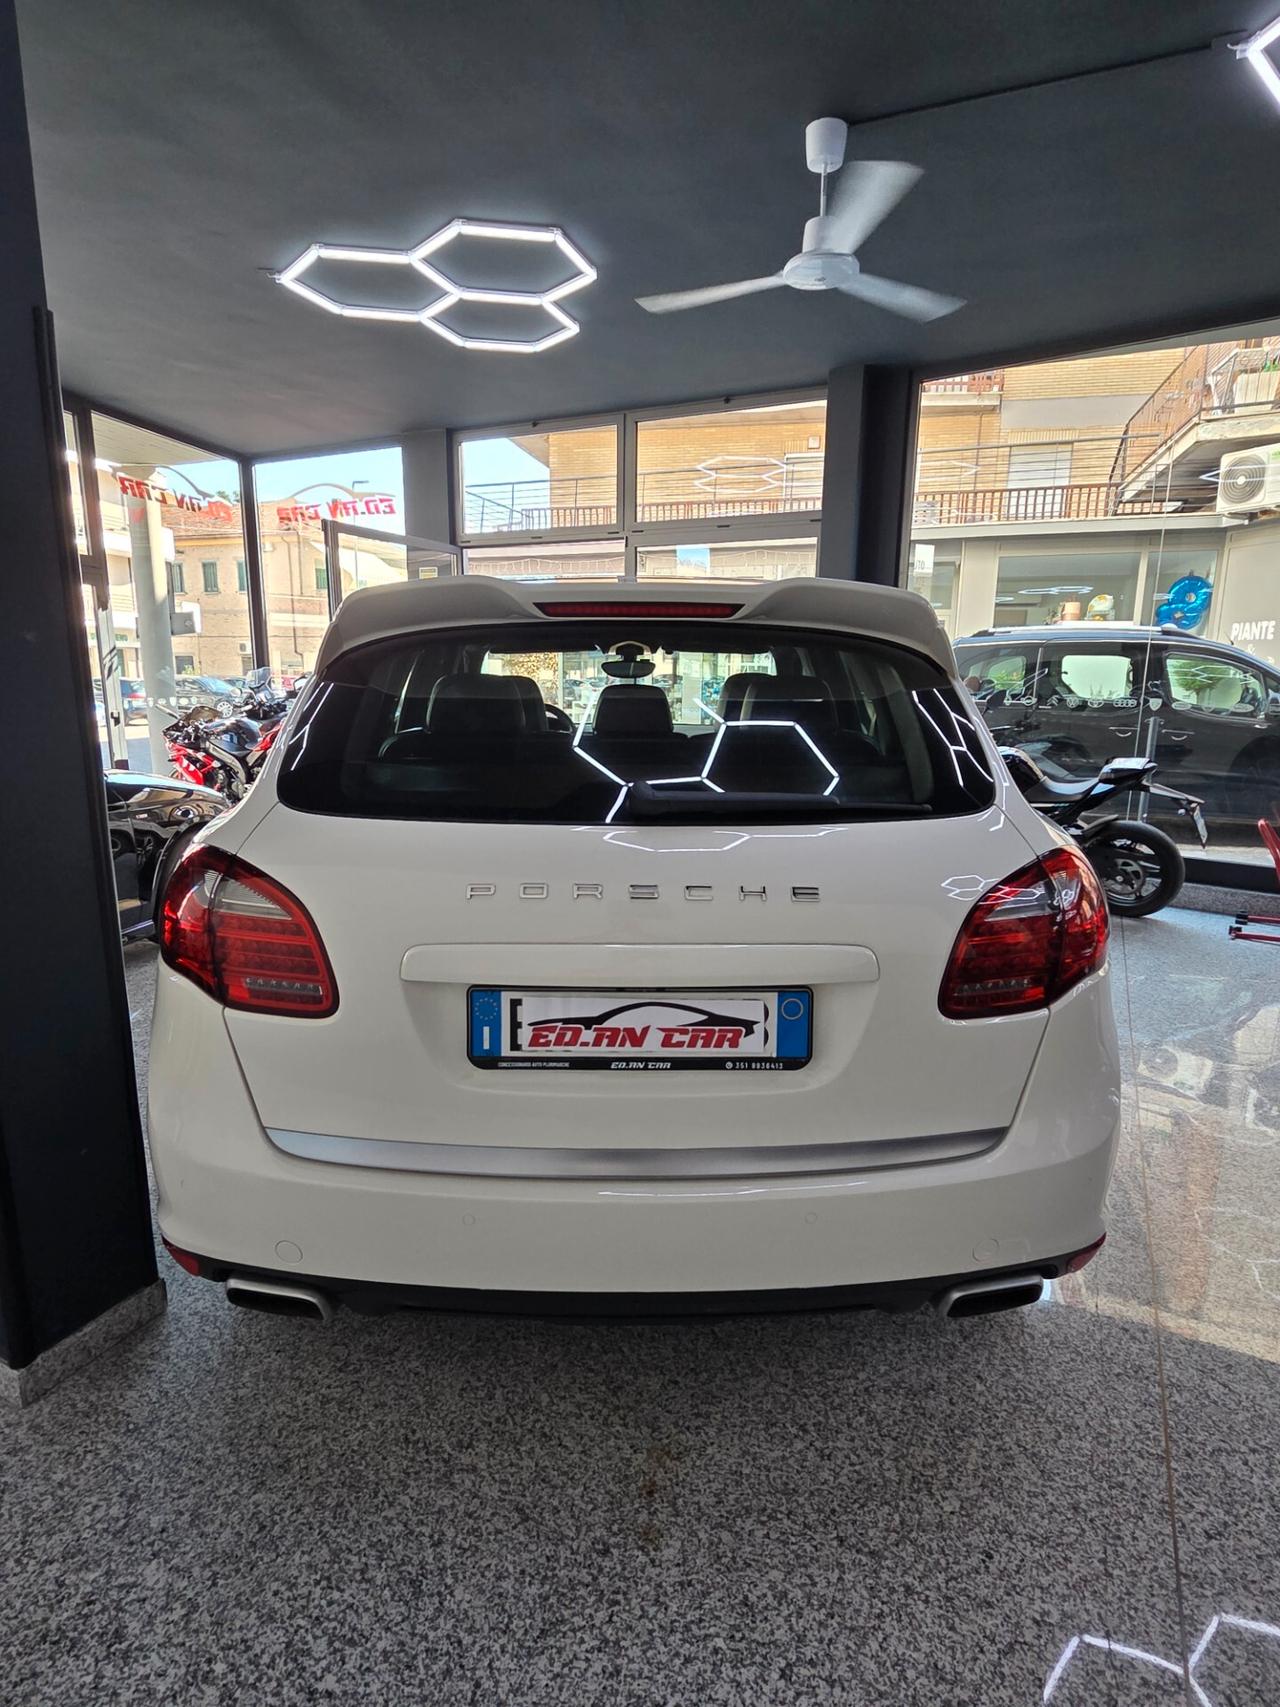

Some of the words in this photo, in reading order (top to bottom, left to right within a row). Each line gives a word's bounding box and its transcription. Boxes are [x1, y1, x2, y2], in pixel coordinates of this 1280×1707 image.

[1230, 620, 1276, 641] PIANTE
[466, 882, 821, 903] PORSCHE
[528, 1024, 651, 1048] ED.AN
[656, 1026, 747, 1049] CAR
[647, 1061, 671, 1070] CAR
